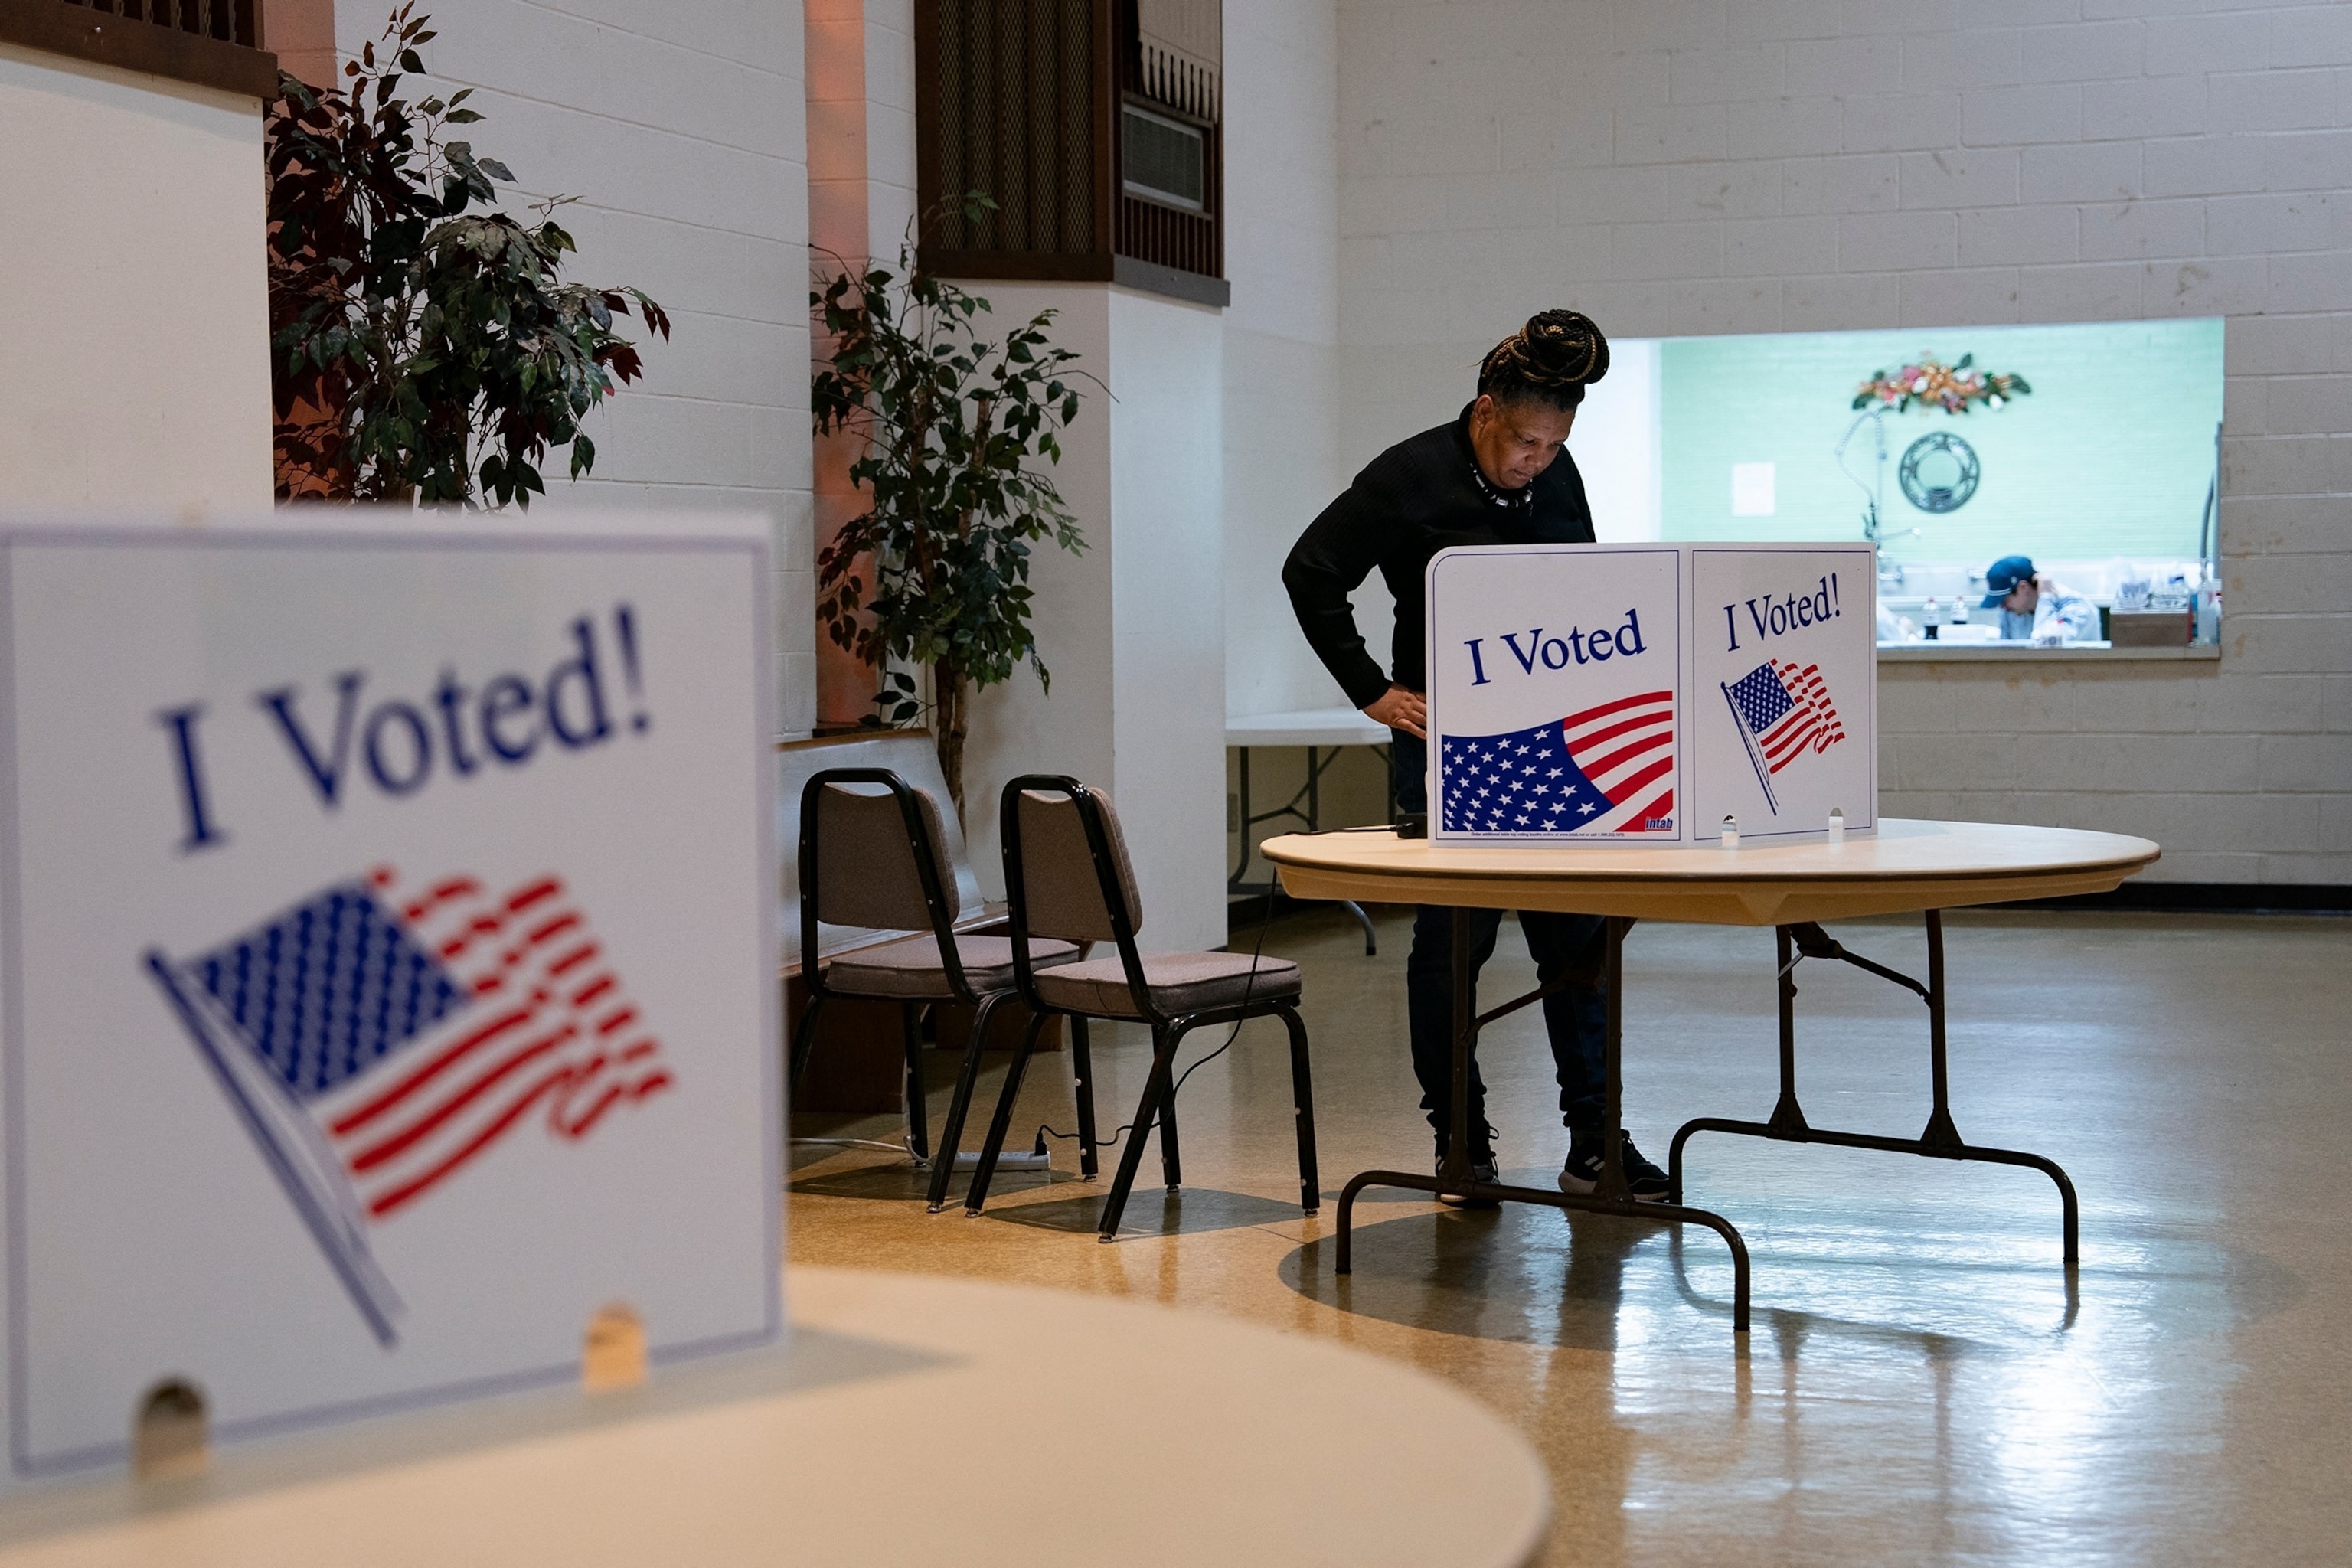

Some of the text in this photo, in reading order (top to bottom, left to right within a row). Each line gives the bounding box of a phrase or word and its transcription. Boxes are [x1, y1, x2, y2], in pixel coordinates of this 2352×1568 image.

[1464, 608, 1647, 686] I Voted
[1723, 572, 1841, 652] I Voted!
[155, 603, 652, 855] I Voted!
[1646, 817, 1673, 828] intab
